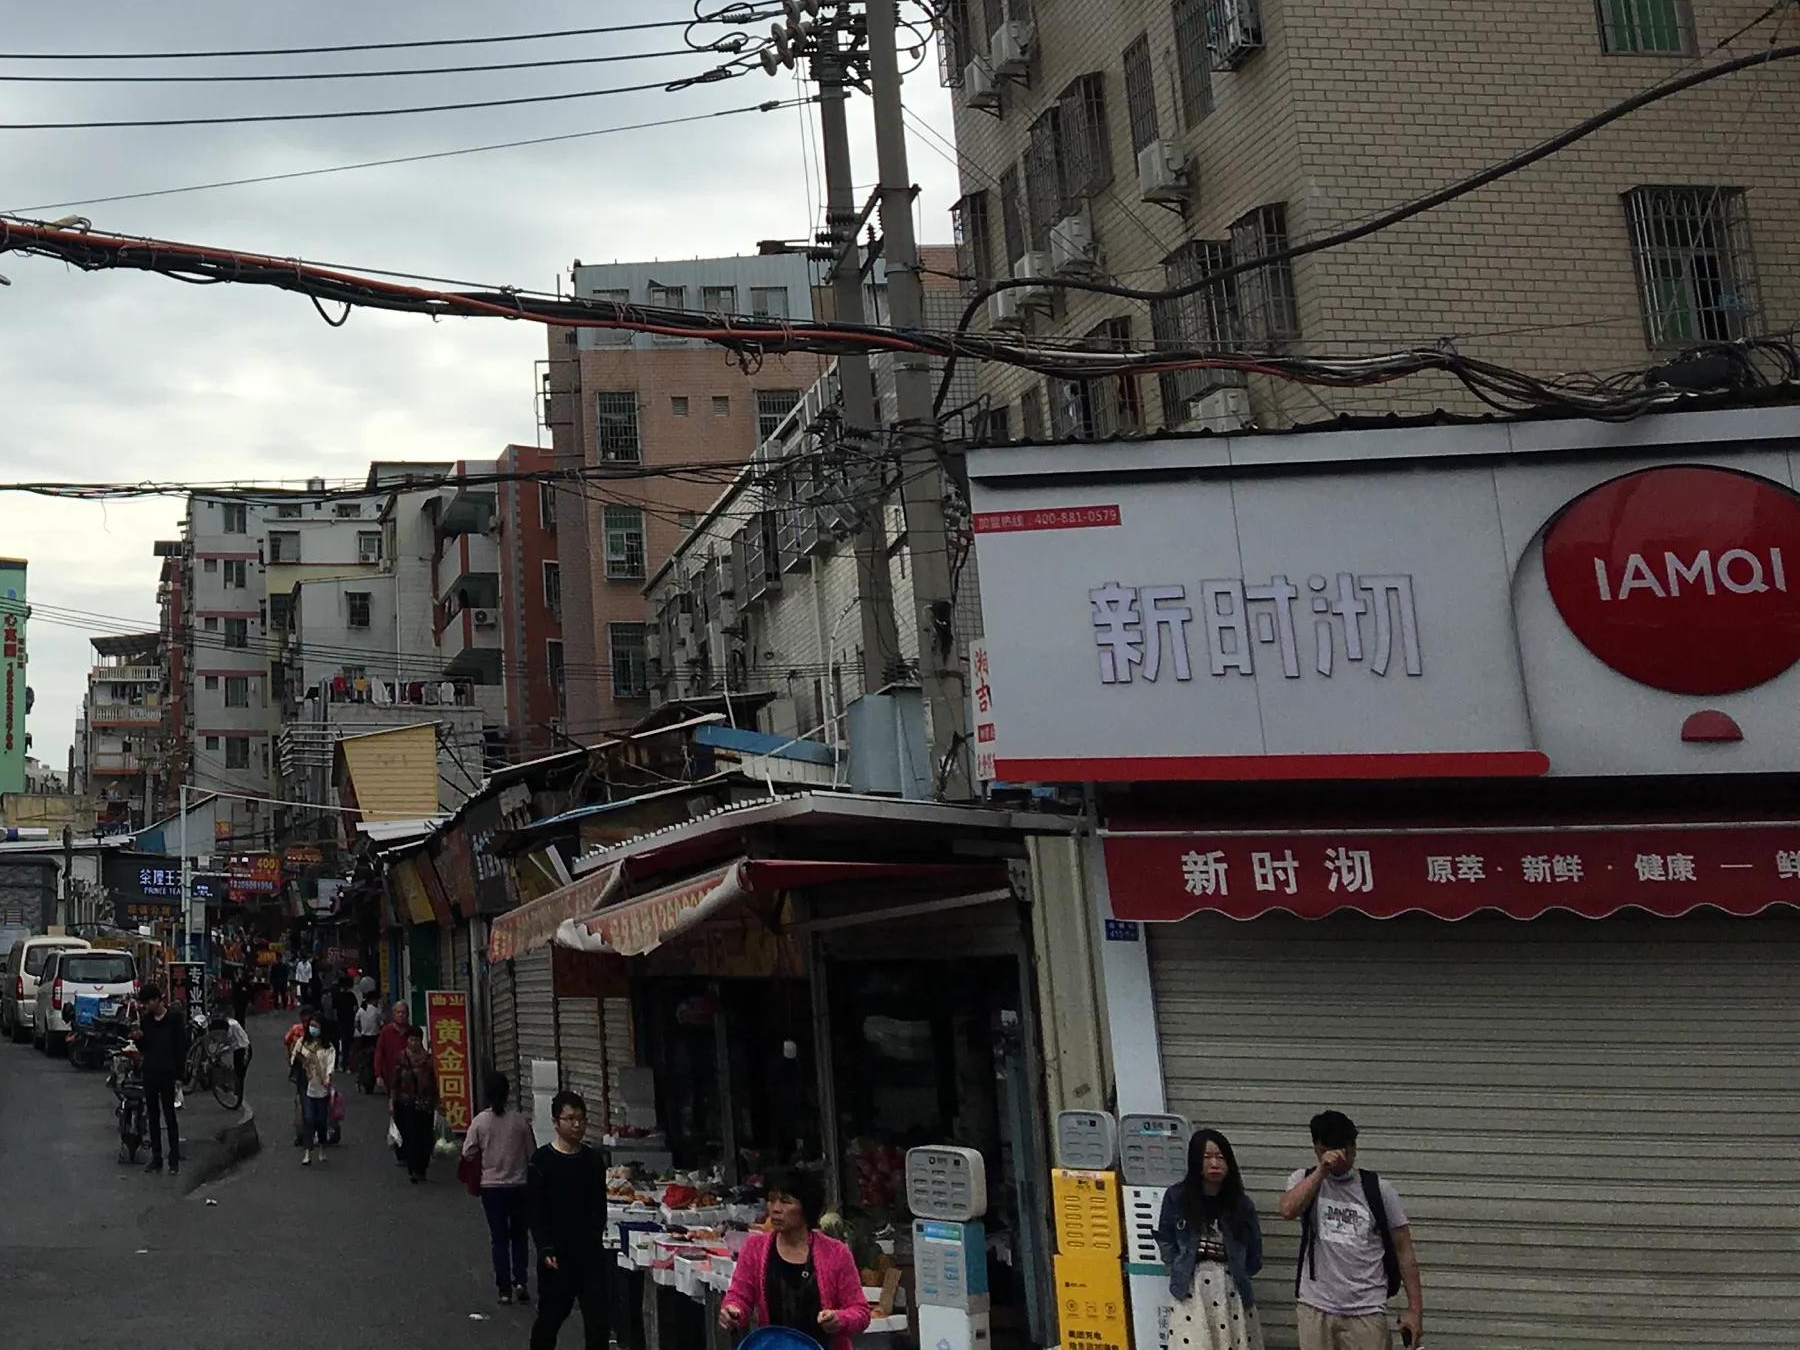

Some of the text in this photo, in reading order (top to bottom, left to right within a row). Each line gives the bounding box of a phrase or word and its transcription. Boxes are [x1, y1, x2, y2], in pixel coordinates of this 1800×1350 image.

[1594, 548, 1787, 600] IAMQI
[1089, 573, 1423, 683] 新时沏
[1181, 847, 1373, 895] 新时沏
